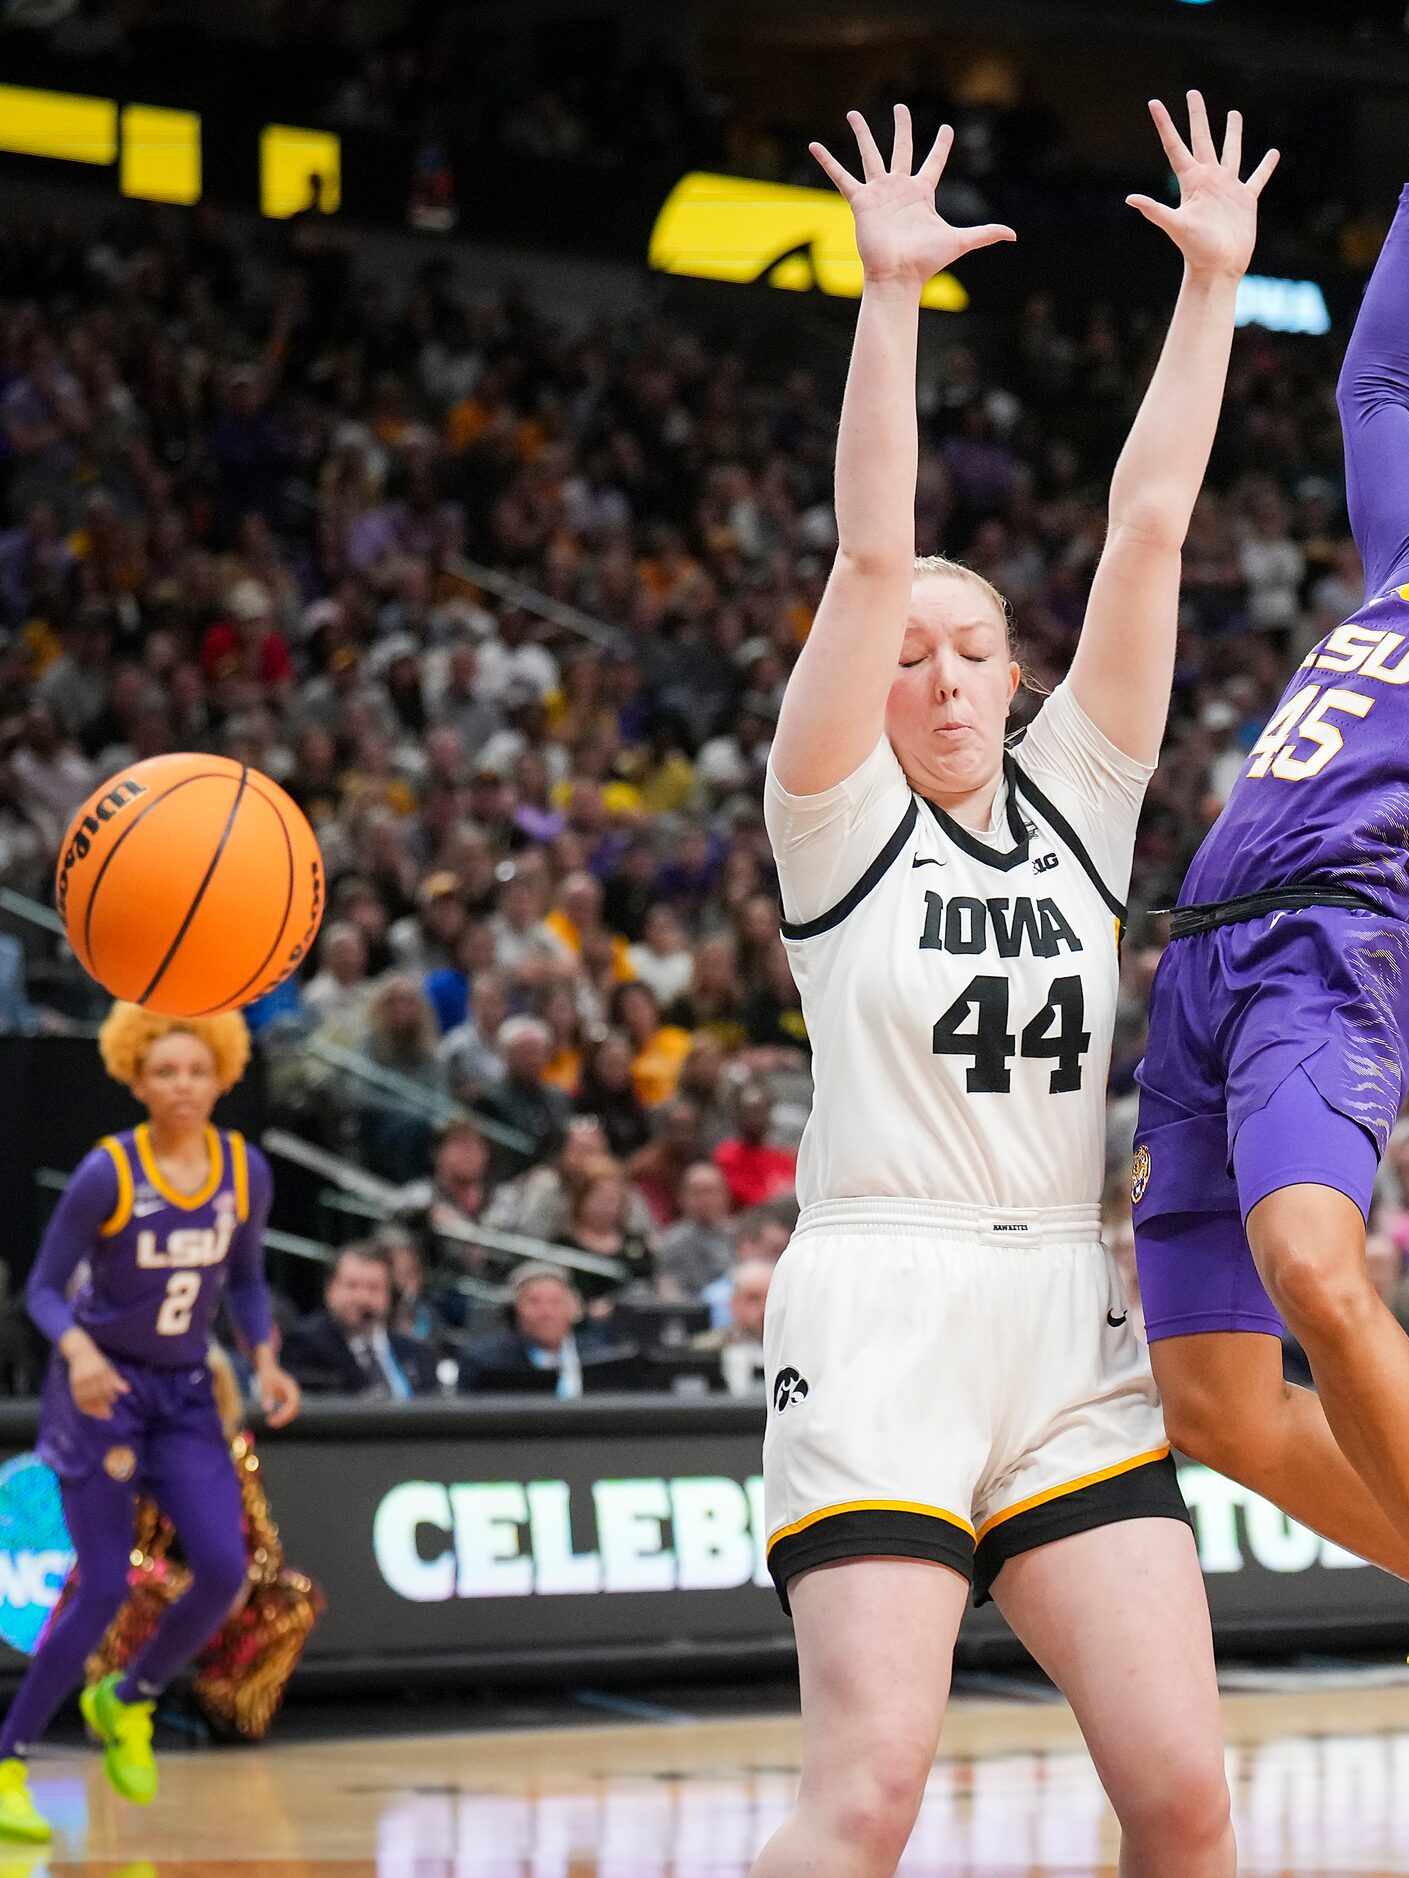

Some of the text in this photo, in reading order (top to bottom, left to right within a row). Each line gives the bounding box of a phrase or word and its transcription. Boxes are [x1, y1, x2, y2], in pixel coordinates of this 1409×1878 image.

[1246, 684, 1376, 782] 45
[919, 890, 1083, 958] IOWA
[932, 974, 1092, 1094] 44
[136, 1210, 237, 1269] LSU
[156, 1271, 201, 1336] 2
